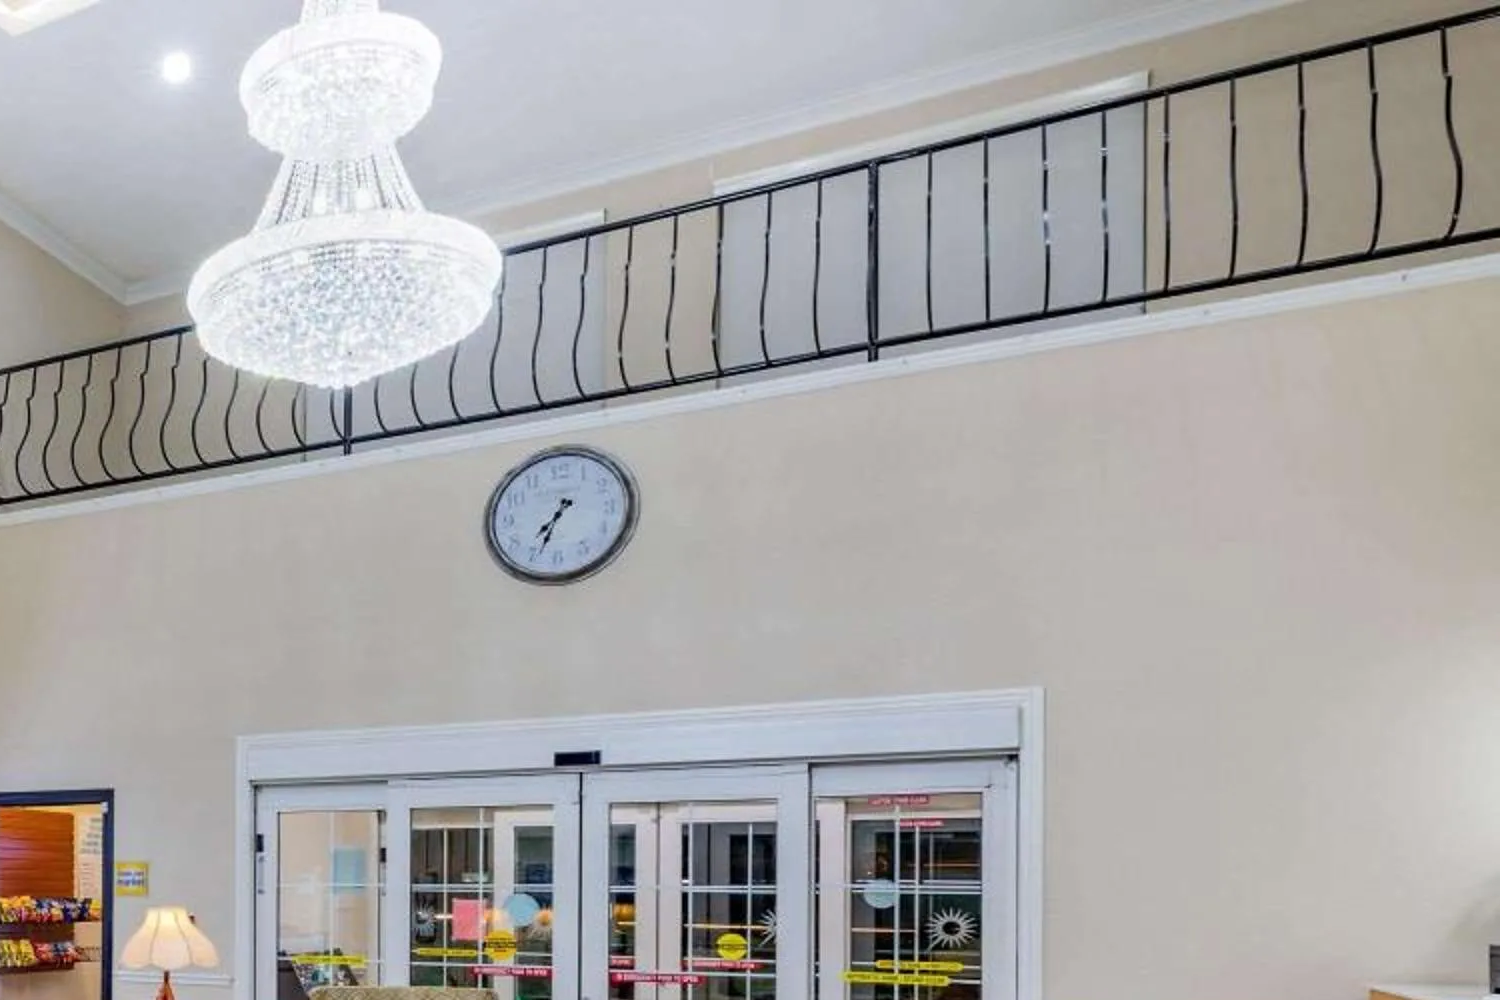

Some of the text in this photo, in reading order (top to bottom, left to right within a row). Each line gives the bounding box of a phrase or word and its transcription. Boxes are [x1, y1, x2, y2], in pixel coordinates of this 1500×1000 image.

[551, 463, 569, 479] 12
[525, 474, 539, 488] 11
[506, 490, 526, 509] 10
